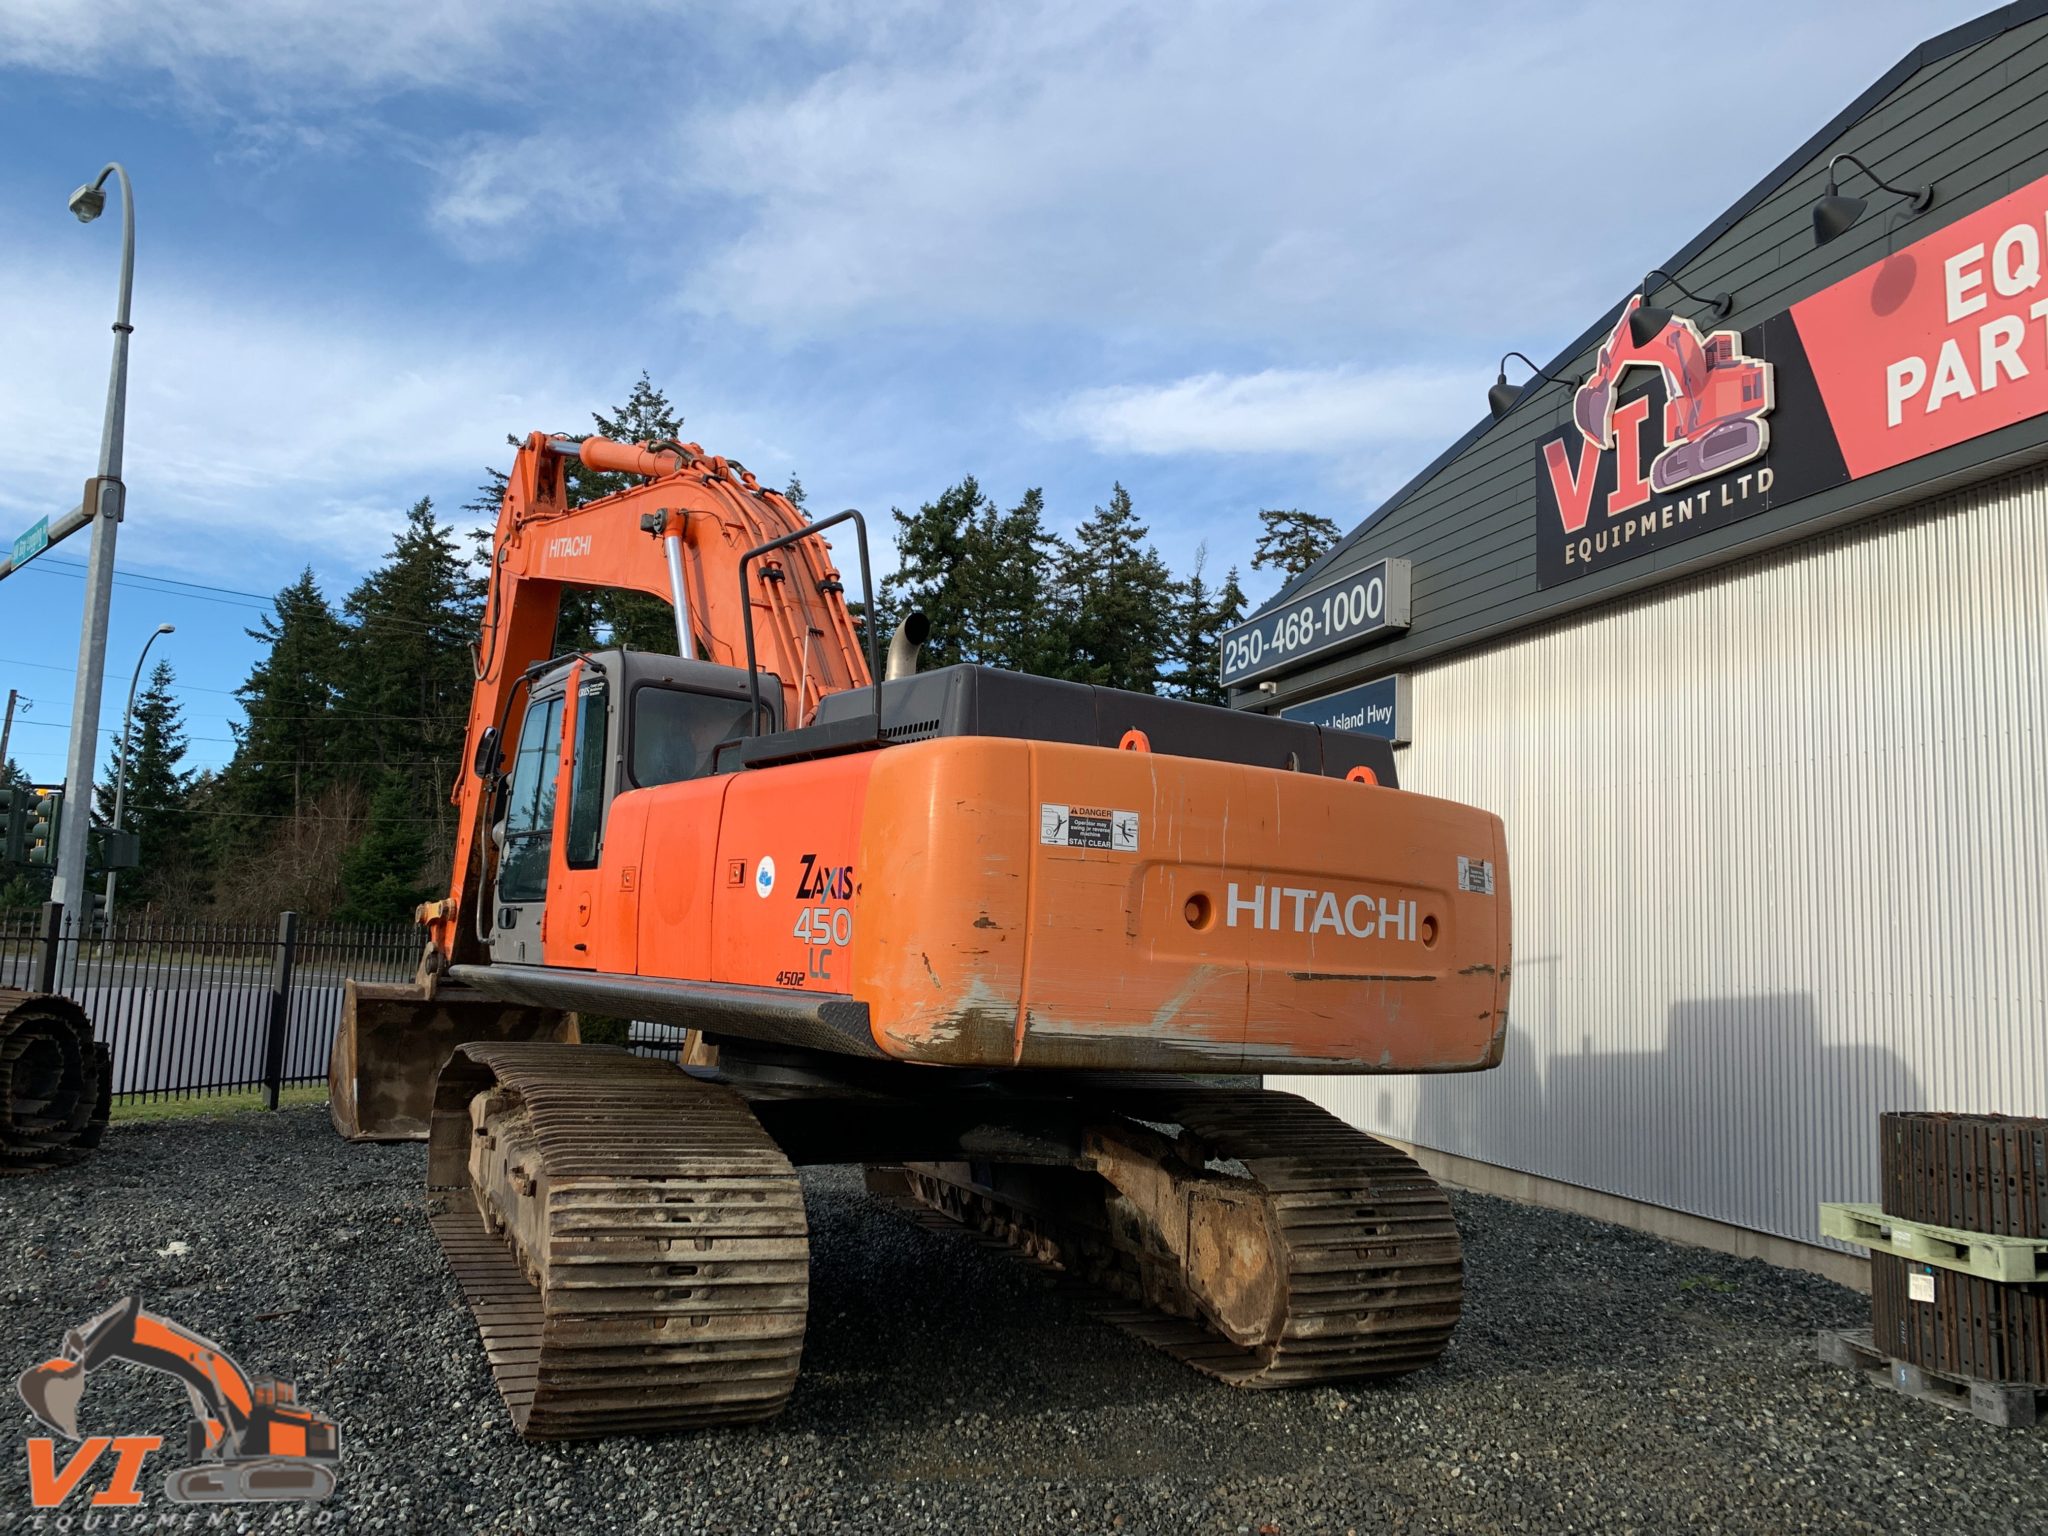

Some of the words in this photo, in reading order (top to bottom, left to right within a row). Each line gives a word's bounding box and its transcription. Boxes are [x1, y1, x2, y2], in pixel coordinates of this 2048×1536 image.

[1944, 210, 2048, 324] EQ
[1542, 394, 1651, 535] VI
[1565, 490, 1711, 565] EQUIPMENT
[1720, 467, 1774, 507] LTD
[549, 535, 593, 558] HITACHI
[1225, 576, 1383, 675] 250-468-1000
[1333, 707, 1364, 730] Island
[1367, 704, 1393, 725] Hwy
[1079, 807, 1112, 818] DANGER
[1068, 838, 1087, 846] STAY
[1088, 839, 1112, 848] CLEAR
[793, 907, 852, 946] 450
[1227, 883, 1417, 942] HITACHI
[775, 970, 805, 986] 4502
[808, 948, 832, 979] LC
